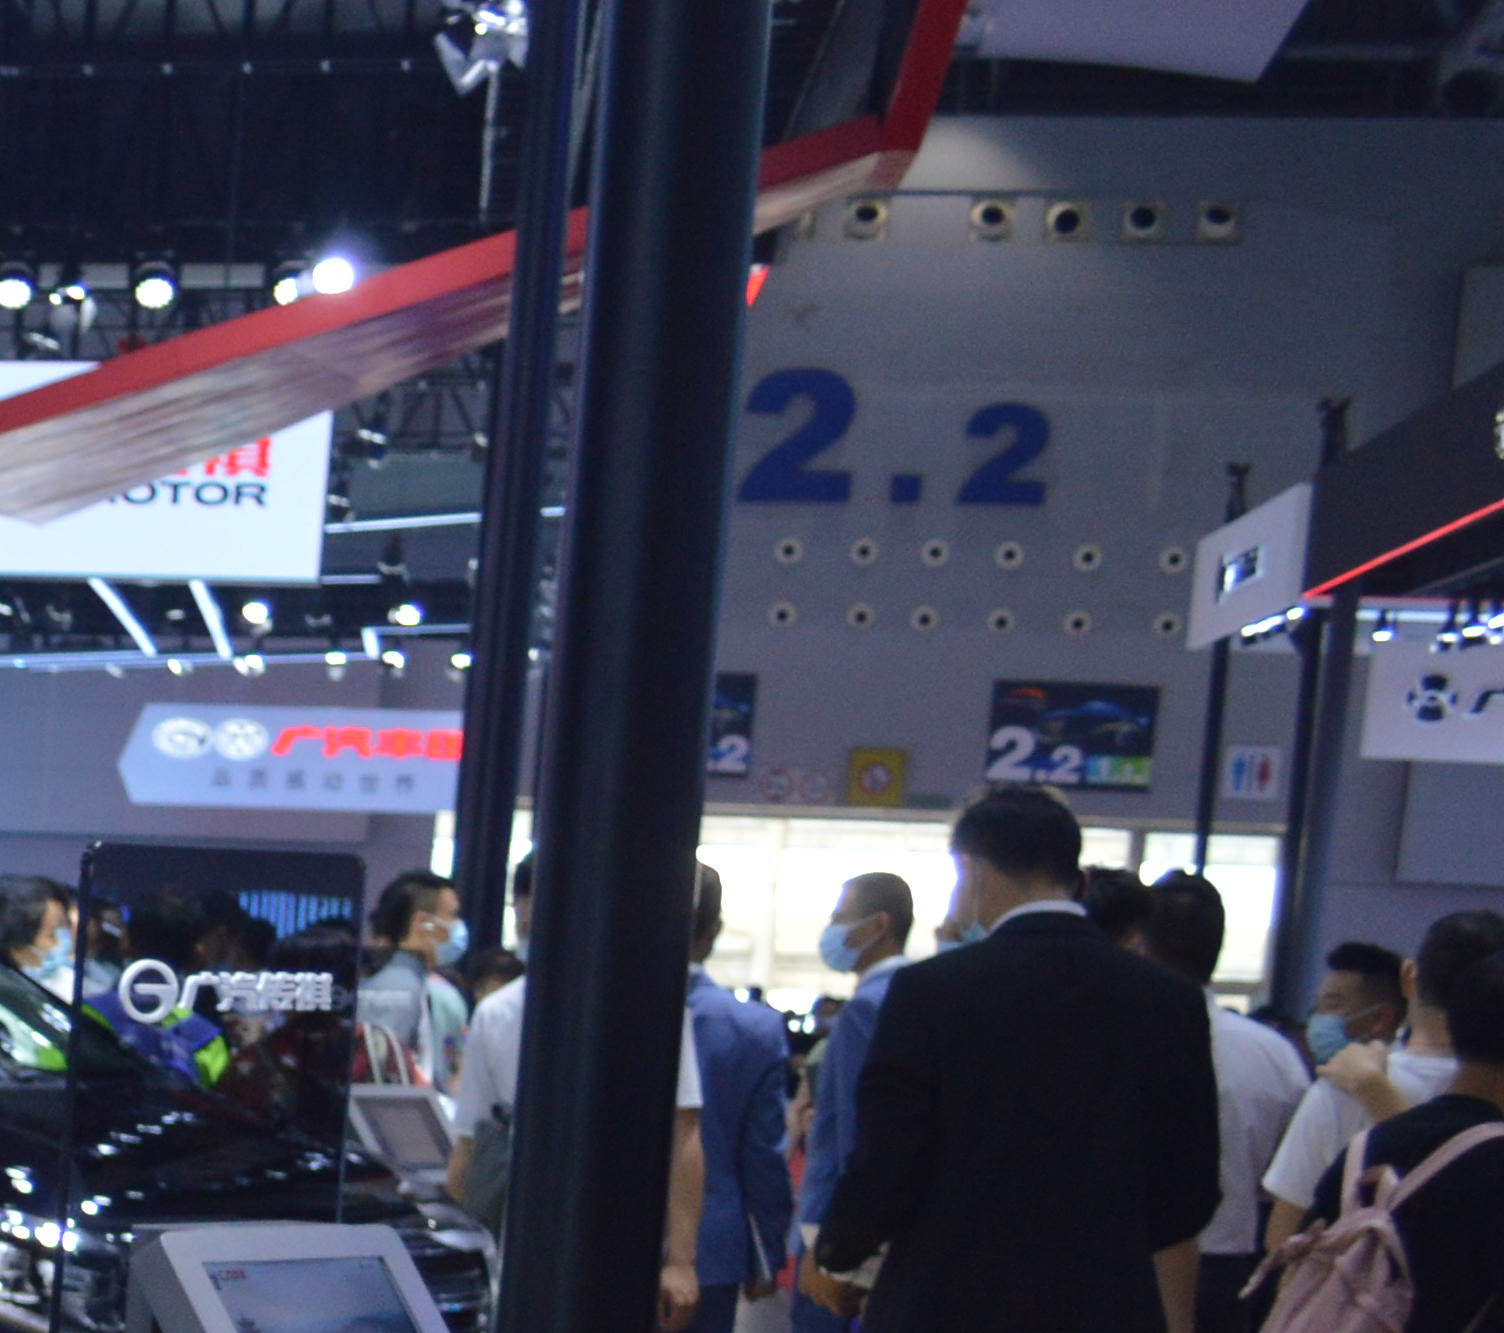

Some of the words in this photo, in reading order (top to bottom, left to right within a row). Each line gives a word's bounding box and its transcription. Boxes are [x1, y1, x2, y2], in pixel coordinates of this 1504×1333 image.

[737, 367, 1051, 506] 2.2
[177, 971, 334, 1012] 广汽传祺
